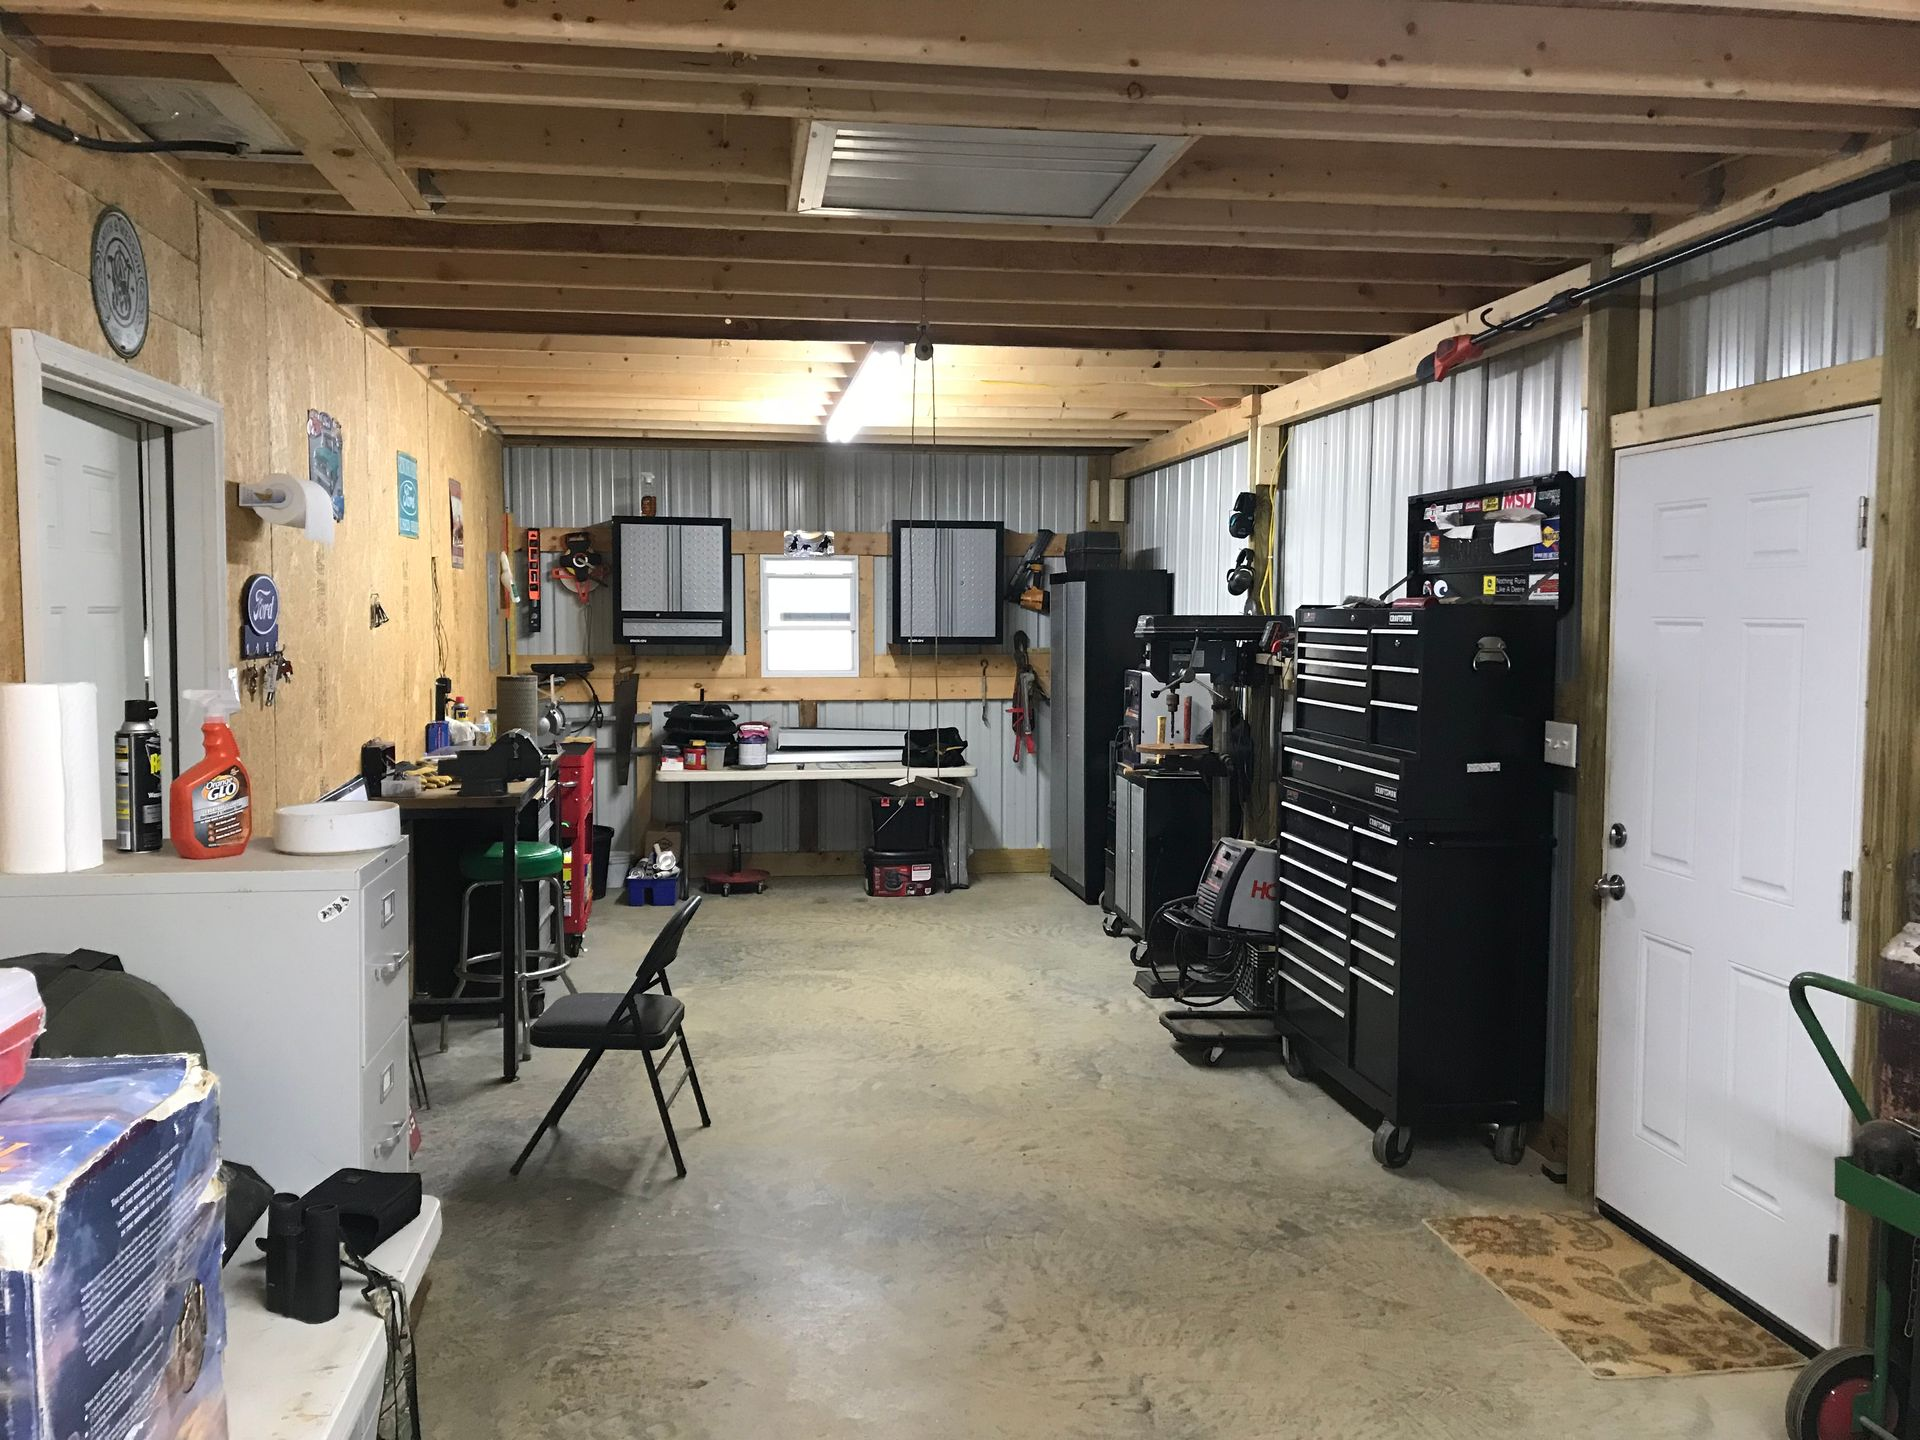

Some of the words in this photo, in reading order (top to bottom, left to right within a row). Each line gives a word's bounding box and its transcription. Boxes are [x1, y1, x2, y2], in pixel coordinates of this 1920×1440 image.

[1503, 488, 1535, 509] MSD
[1497, 577, 1513, 586] Nothing
[1514, 577, 1526, 585] Runs
[253, 589, 275, 621] Ford
[1389, 614, 1412, 623] CRAFTSMAN
[206, 778, 232, 790] Orange
[207, 782, 237, 801] GLO
[1375, 786, 1397, 799] CRAFTSMAN
[1369, 817, 1391, 833] CRAFTSMAN
